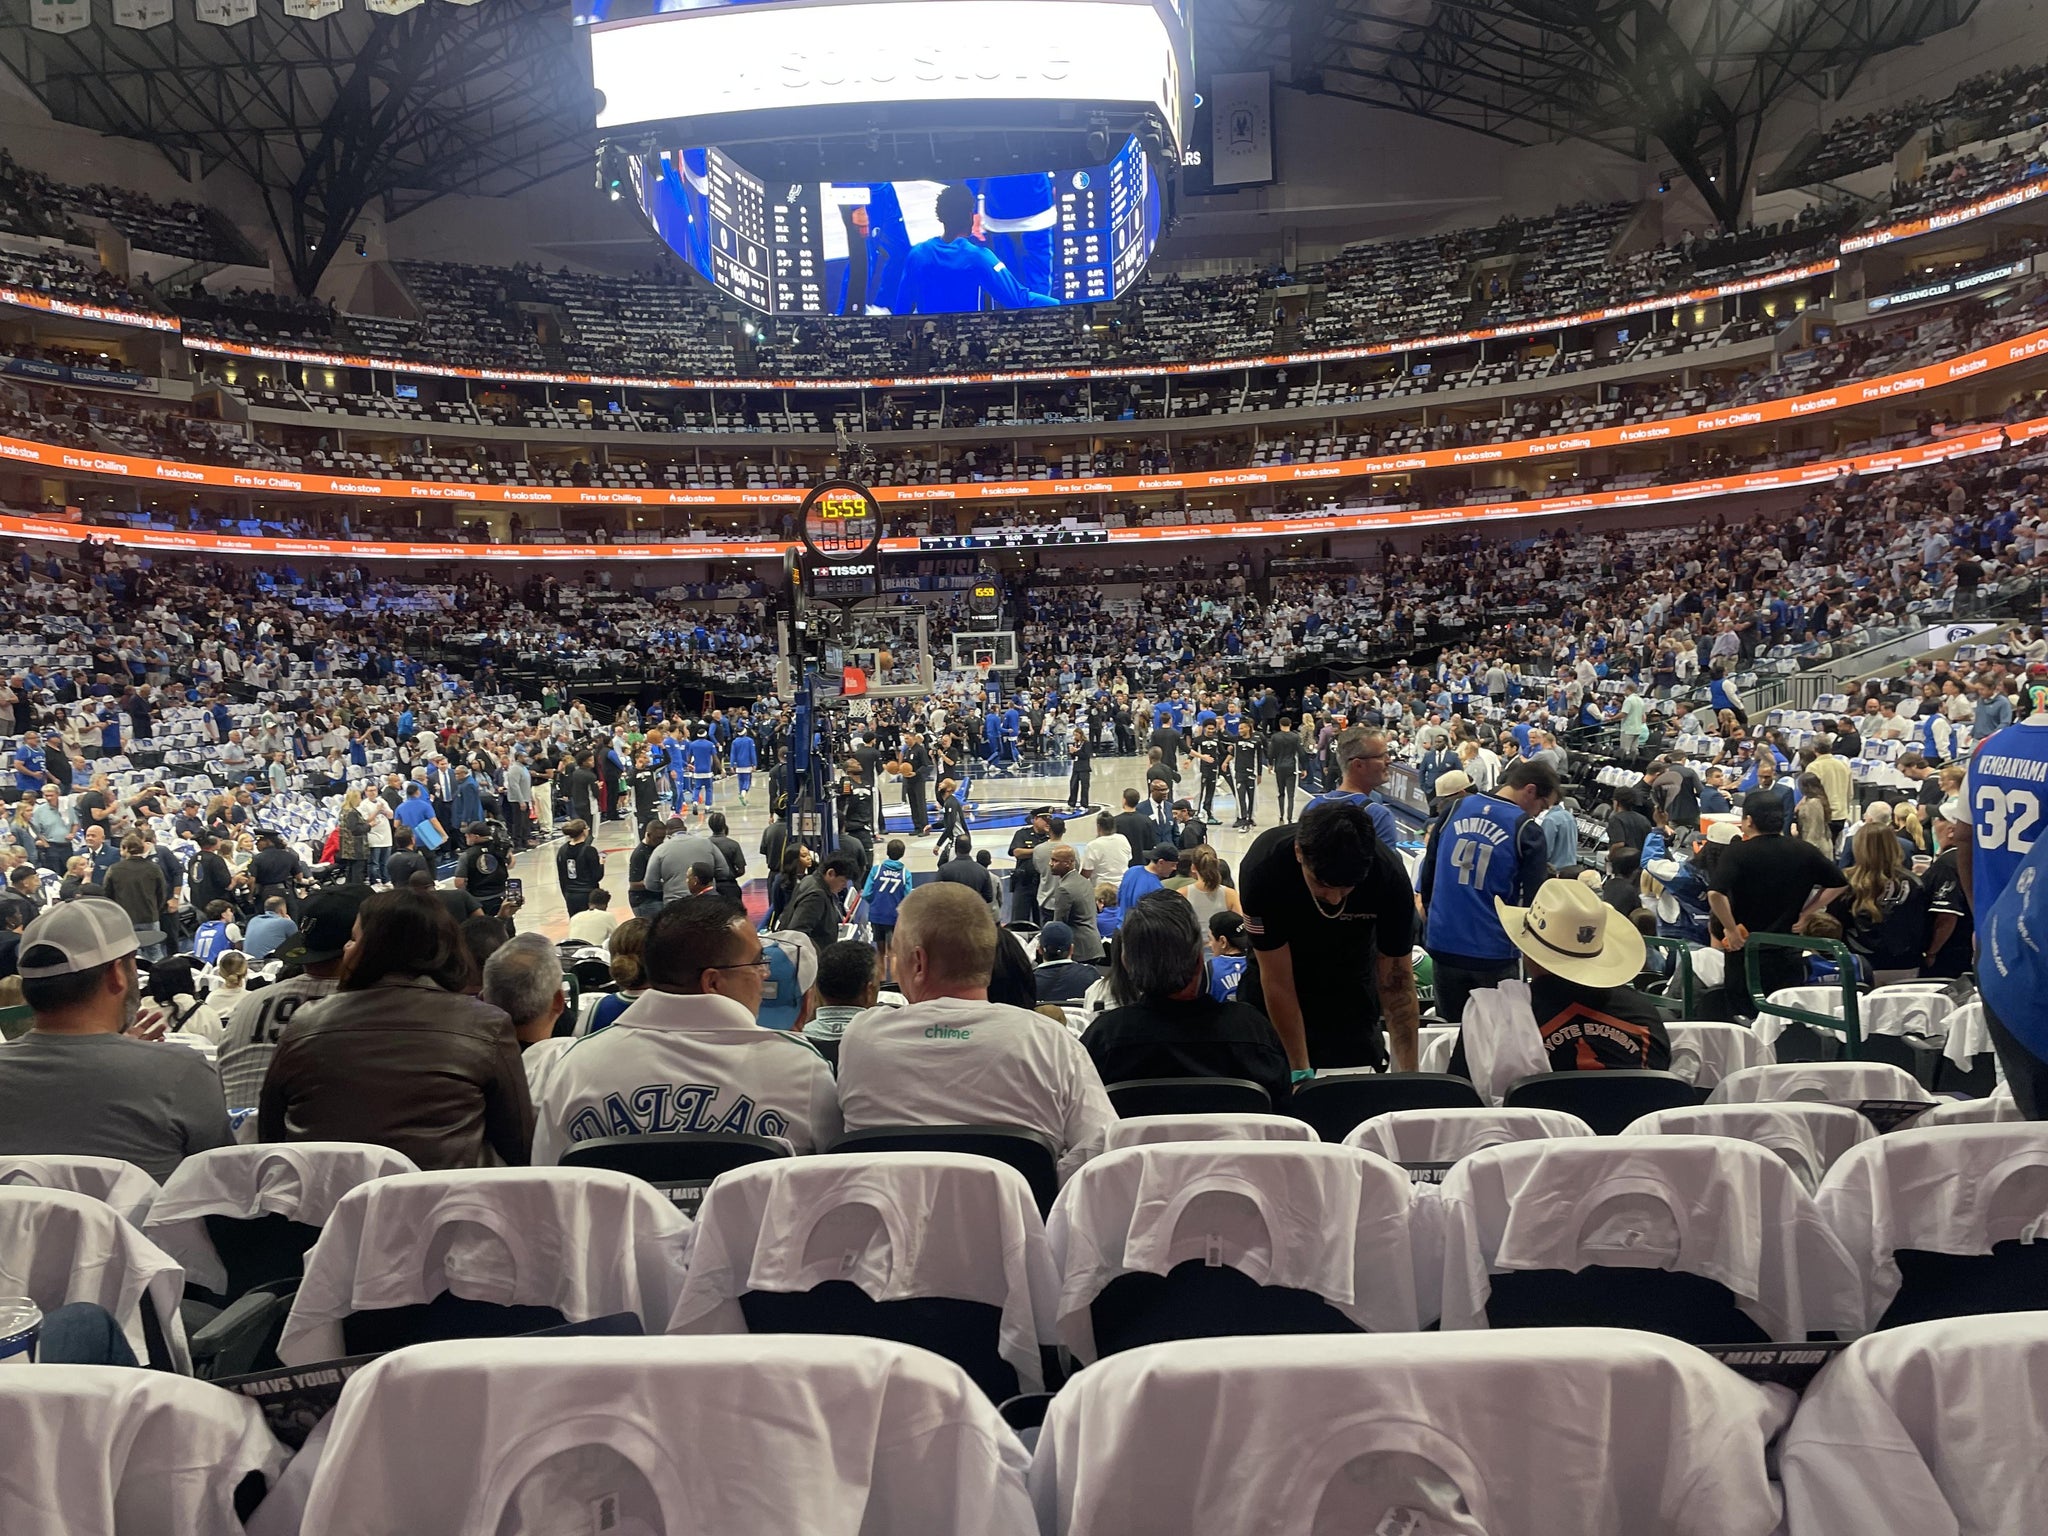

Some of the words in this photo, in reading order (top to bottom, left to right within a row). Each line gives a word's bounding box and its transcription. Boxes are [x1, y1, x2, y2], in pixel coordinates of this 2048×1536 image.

[1930, 214, 1958, 229] Mavs
[1961, 207, 1976, 218] are
[1979, 192, 2023, 213] warming
[2025, 185, 2041, 198] up.
[1718, 285, 1742, 295] Mavs
[1760, 274, 1794, 287] warming
[1890, 290, 1929, 304] MUSTANG
[1929, 284, 1951, 297] CLUB
[51, 300, 80, 315] Mavs
[83, 307, 101, 318] are
[104, 312, 153, 327] warming
[156, 317, 173, 330] up.
[251, 346, 275, 357] Mavs
[278, 351, 290, 360] are
[292, 352, 330, 364] warming
[2010, 347, 2024, 360] Fire
[2025, 345, 2036, 355] for
[371, 359, 393, 369] Mavs
[396, 363, 407, 371] are
[409, 363, 443, 375] warming
[1863, 389, 1878, 397] Fire
[1893, 378, 1925, 391] Chilling
[1698, 421, 1713, 429] Fire
[1716, 418, 1727, 426] for
[1729, 413, 1761, 424] Chilling
[1560, 439, 1590, 449] Chilling
[63, 456, 78, 465] Fire
[80, 458, 92, 467] for
[95, 460, 128, 474] Chilling
[1396, 459, 1426, 468] Chilling
[234, 475, 250, 484] Fire
[254, 477, 266, 485] for
[269, 478, 302, 490] Chilling
[1239, 474, 1267, 482] Chilling
[411, 487, 427, 495] Fire
[430, 488, 441, 496] for
[444, 489, 476, 499] Chilling
[611, 494, 642, 503] Chilling
[927, 490, 955, 498] Chilling
[822, 500, 866, 518] 15:59
[829, 565, 875, 576] TISSOT
[1978, 755, 2048, 783] WEMBANYAMA
[1976, 786, 2040, 855] 32
[1453, 817, 1509, 846] NOWITZKI
[1450, 838, 1494, 891] 41
[879, 876, 902, 894] 77
[925, 1023, 970, 1040] chime
[1584, 1022, 1640, 1055] EXHIBIT
[568, 1084, 790, 1143] DALLAS
[673, 1187, 699, 1200] MAVS
[1722, 1351, 1777, 1365] MAVS
[1777, 1350, 1827, 1364] YOUR
[241, 1377, 293, 1396] MAVS
[291, 1369, 340, 1389] YOUR
